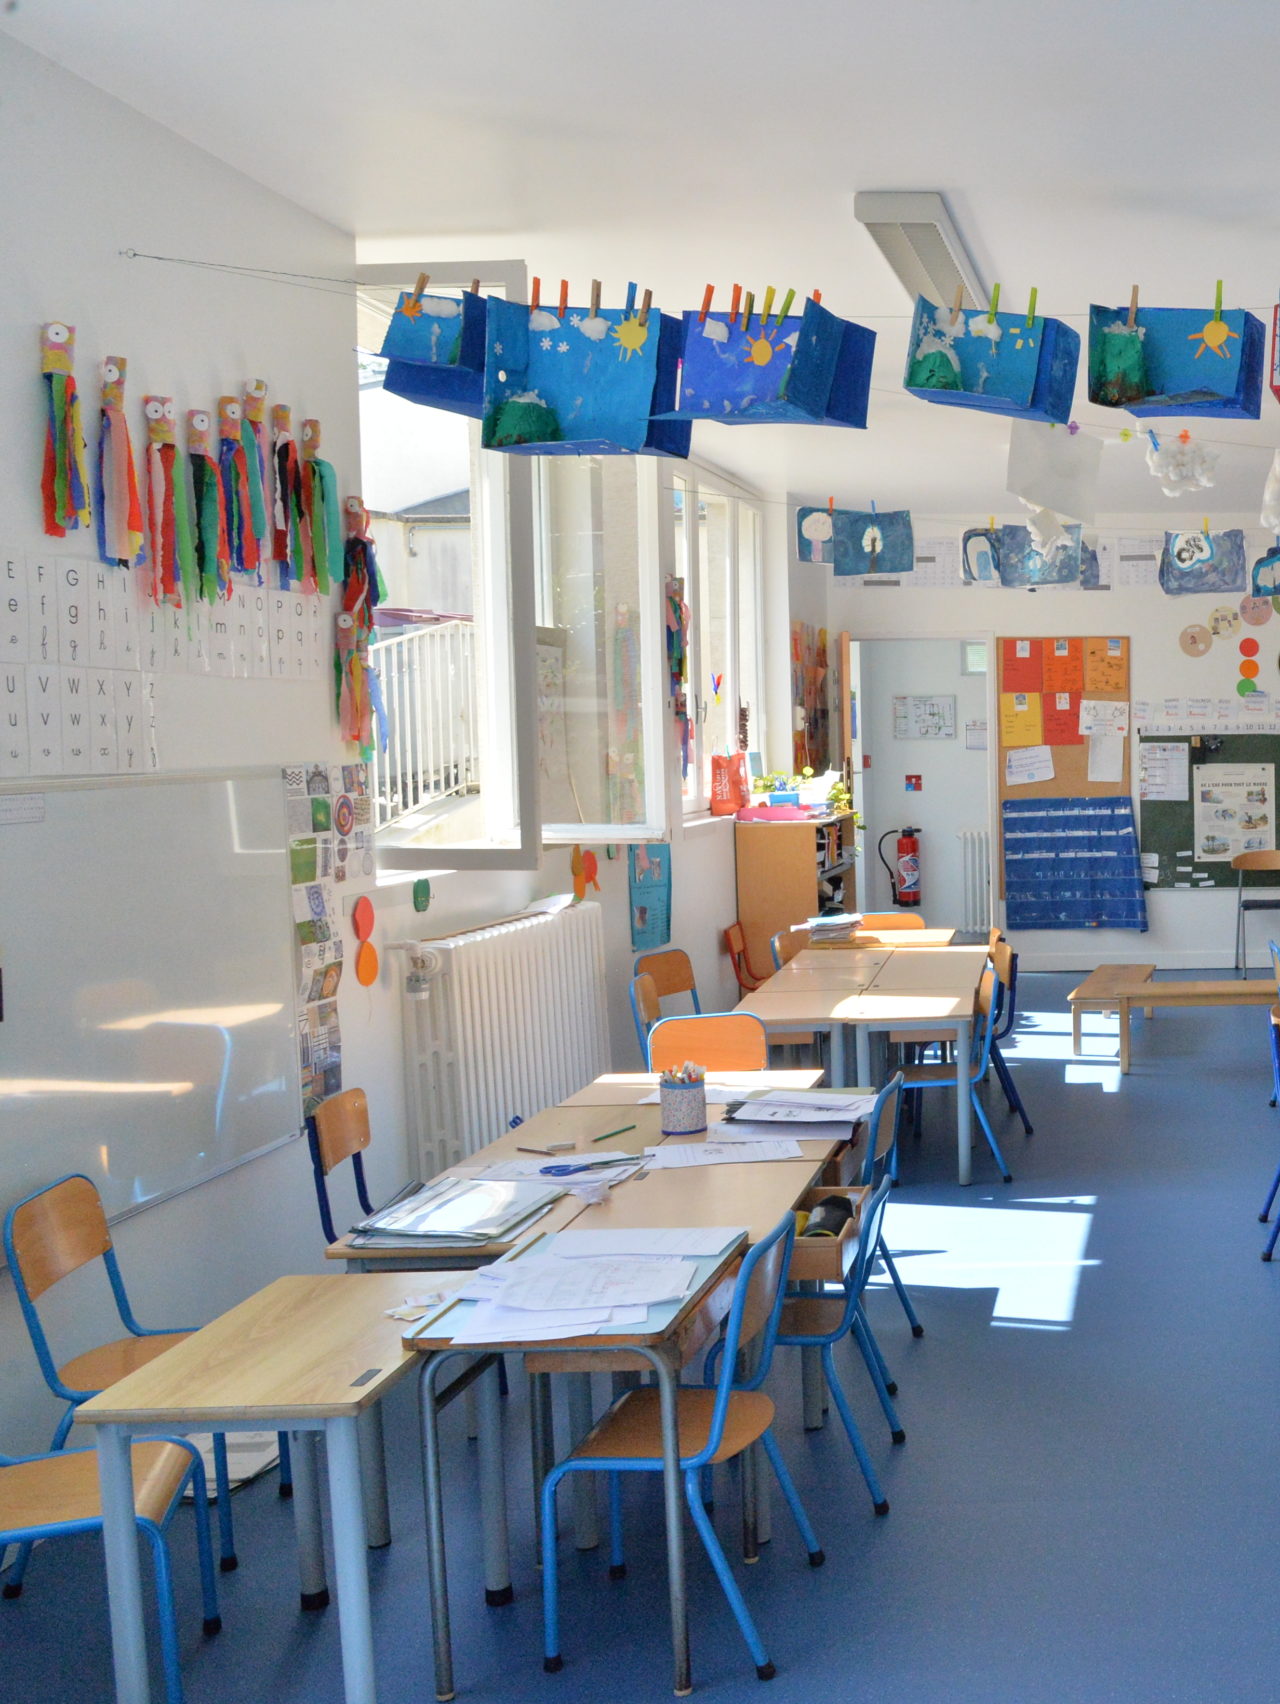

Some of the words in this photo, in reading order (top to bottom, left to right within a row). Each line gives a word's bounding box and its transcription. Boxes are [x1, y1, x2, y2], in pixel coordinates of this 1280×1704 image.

[7, 561, 15, 579] E
[38, 566, 44, 583] F
[66, 569, 79, 587] G
[97, 573, 105, 590] H
[239, 595, 245, 609] N
[256, 597, 263, 611] O
[277, 600, 283, 613] P
[8, 598, 18, 612] e
[41, 595, 46, 615] f
[69, 605, 78, 624] g
[98, 600, 106, 620] h
[174, 612, 180, 629] k
[215, 622, 227, 634] m
[240, 624, 246, 635] n
[258, 626, 264, 638] o
[277, 629, 284, 645] p
[297, 631, 303, 646] q
[6, 675, 15, 693] U
[38, 676, 49, 693] V
[68, 677, 80, 694] W
[97, 679, 106, 696] X
[124, 681, 132, 697] Y
[8, 713, 17, 727] u
[41, 712, 50, 726] v
[70, 713, 81, 726] w
[100, 714, 107, 726] x
[126, 715, 133, 733] y
